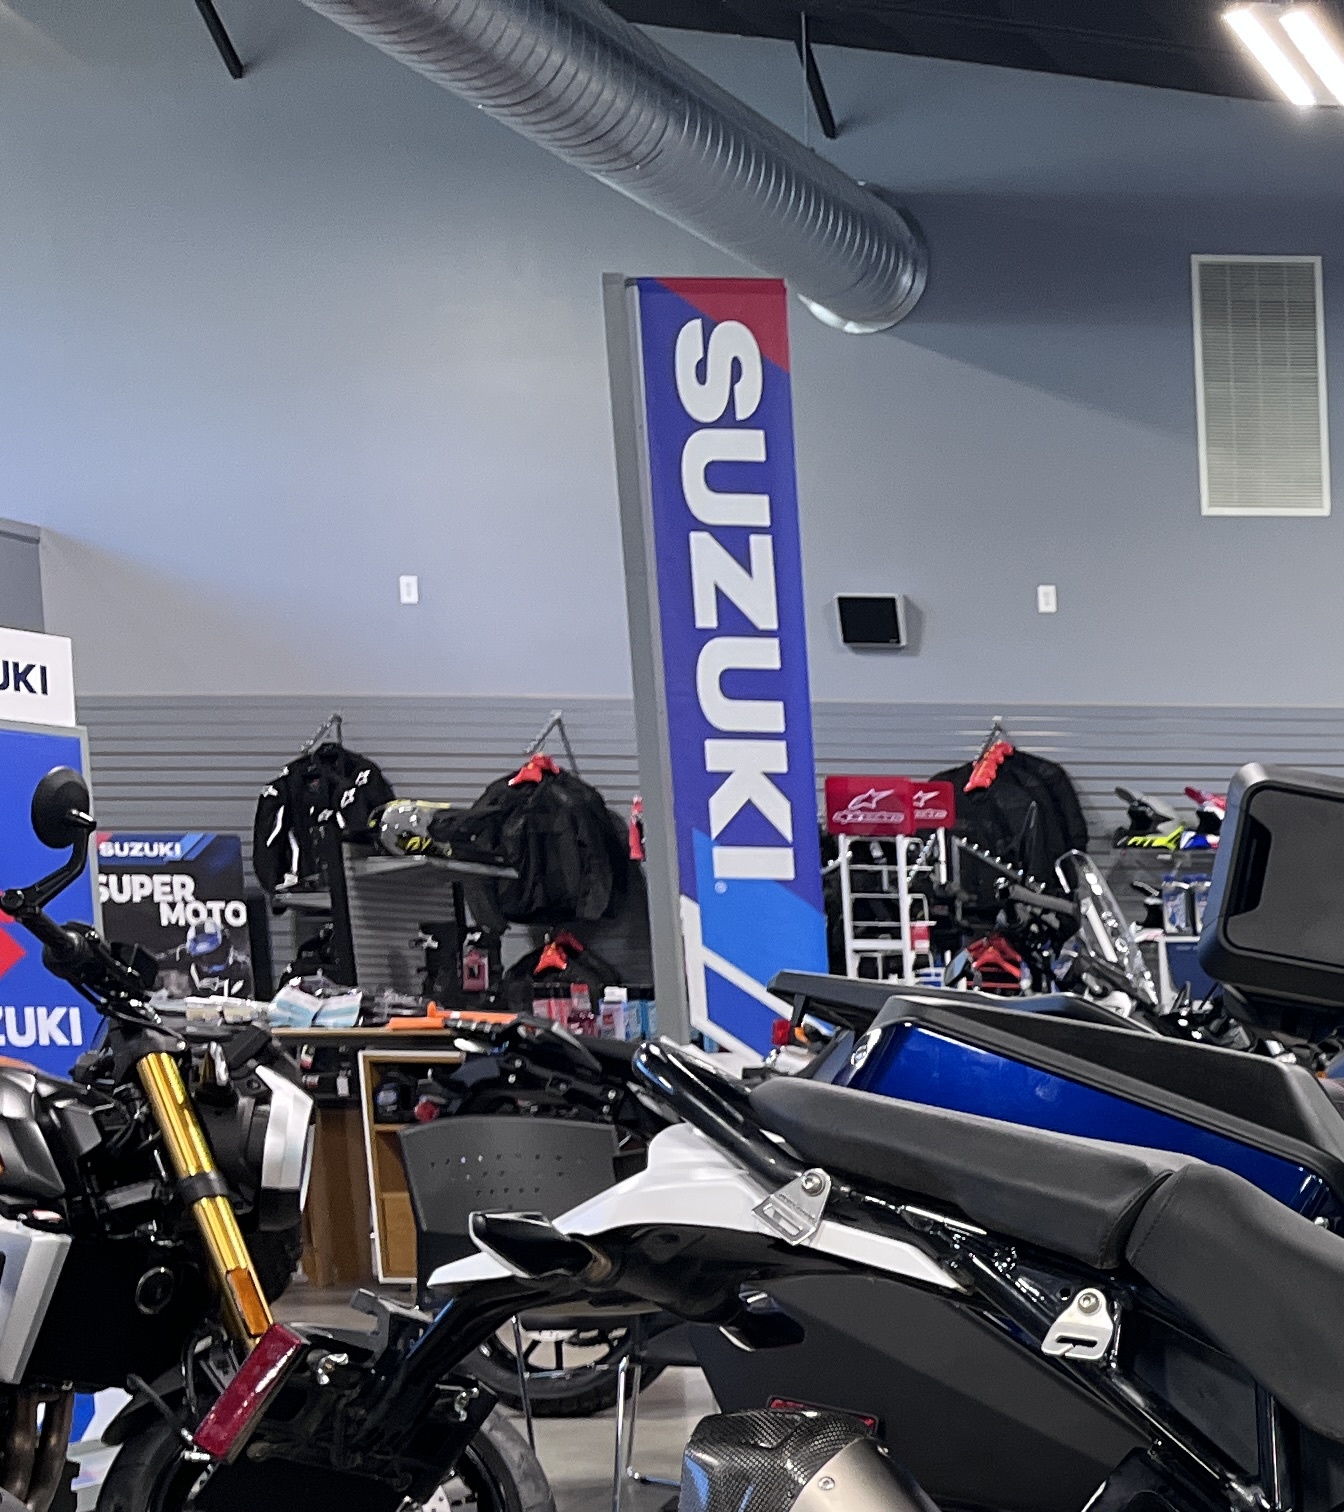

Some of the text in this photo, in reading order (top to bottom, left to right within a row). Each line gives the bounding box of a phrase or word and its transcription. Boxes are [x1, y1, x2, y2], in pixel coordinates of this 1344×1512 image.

[674, 318, 796, 881] SUZUKI
[98, 842, 182, 857] SUZUKI
[98, 873, 198, 903] SUPER
[160, 900, 248, 928] MOTO
[0, 1005, 83, 1048] UKI
